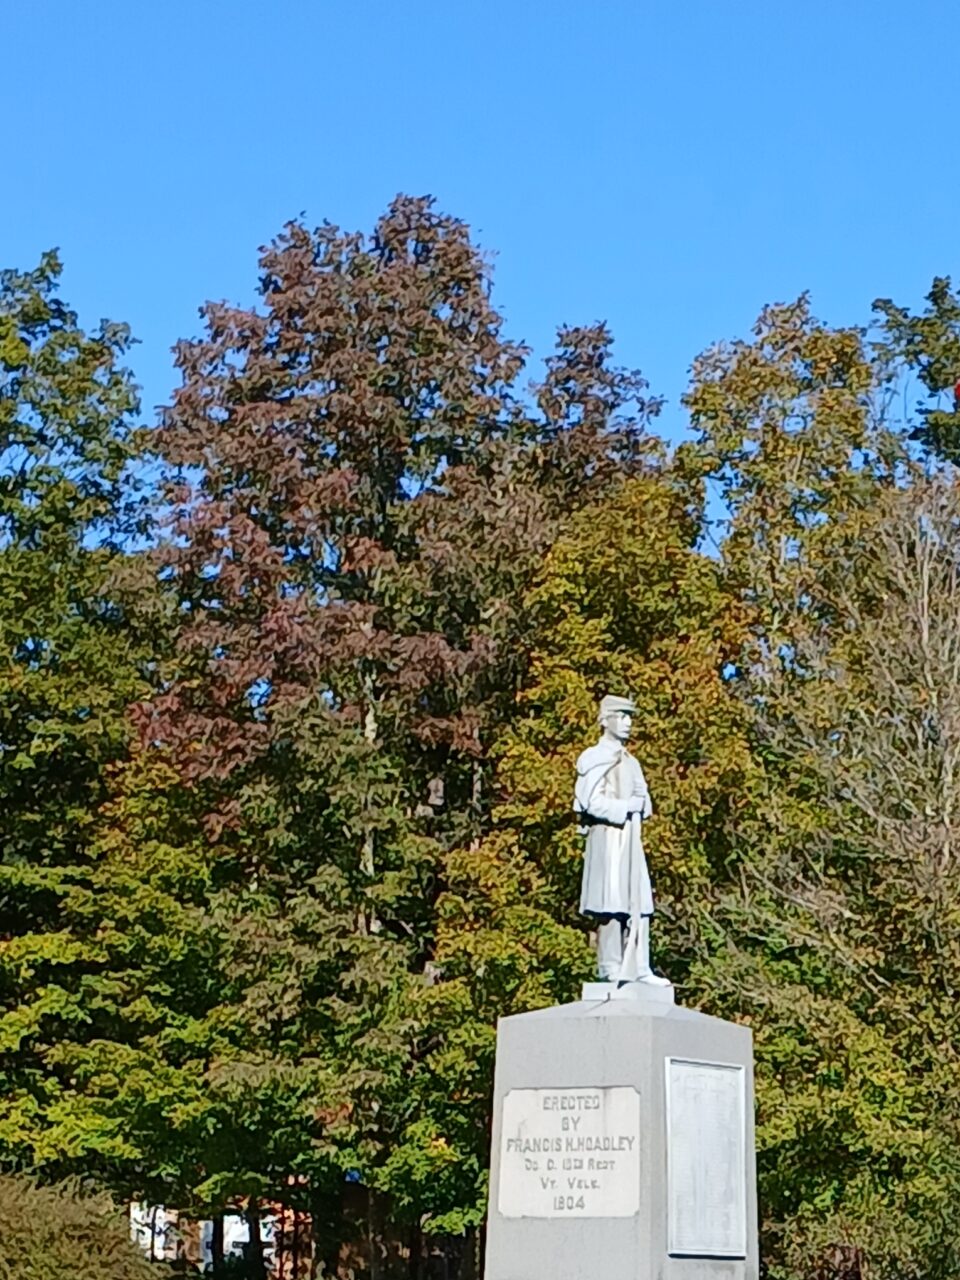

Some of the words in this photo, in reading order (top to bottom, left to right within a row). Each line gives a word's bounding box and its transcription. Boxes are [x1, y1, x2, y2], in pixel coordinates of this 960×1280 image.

[543, 1095, 600, 1111] ERECTED
[561, 1116, 581, 1131] BY
[506, 1137, 562, 1153] FRANCIS
